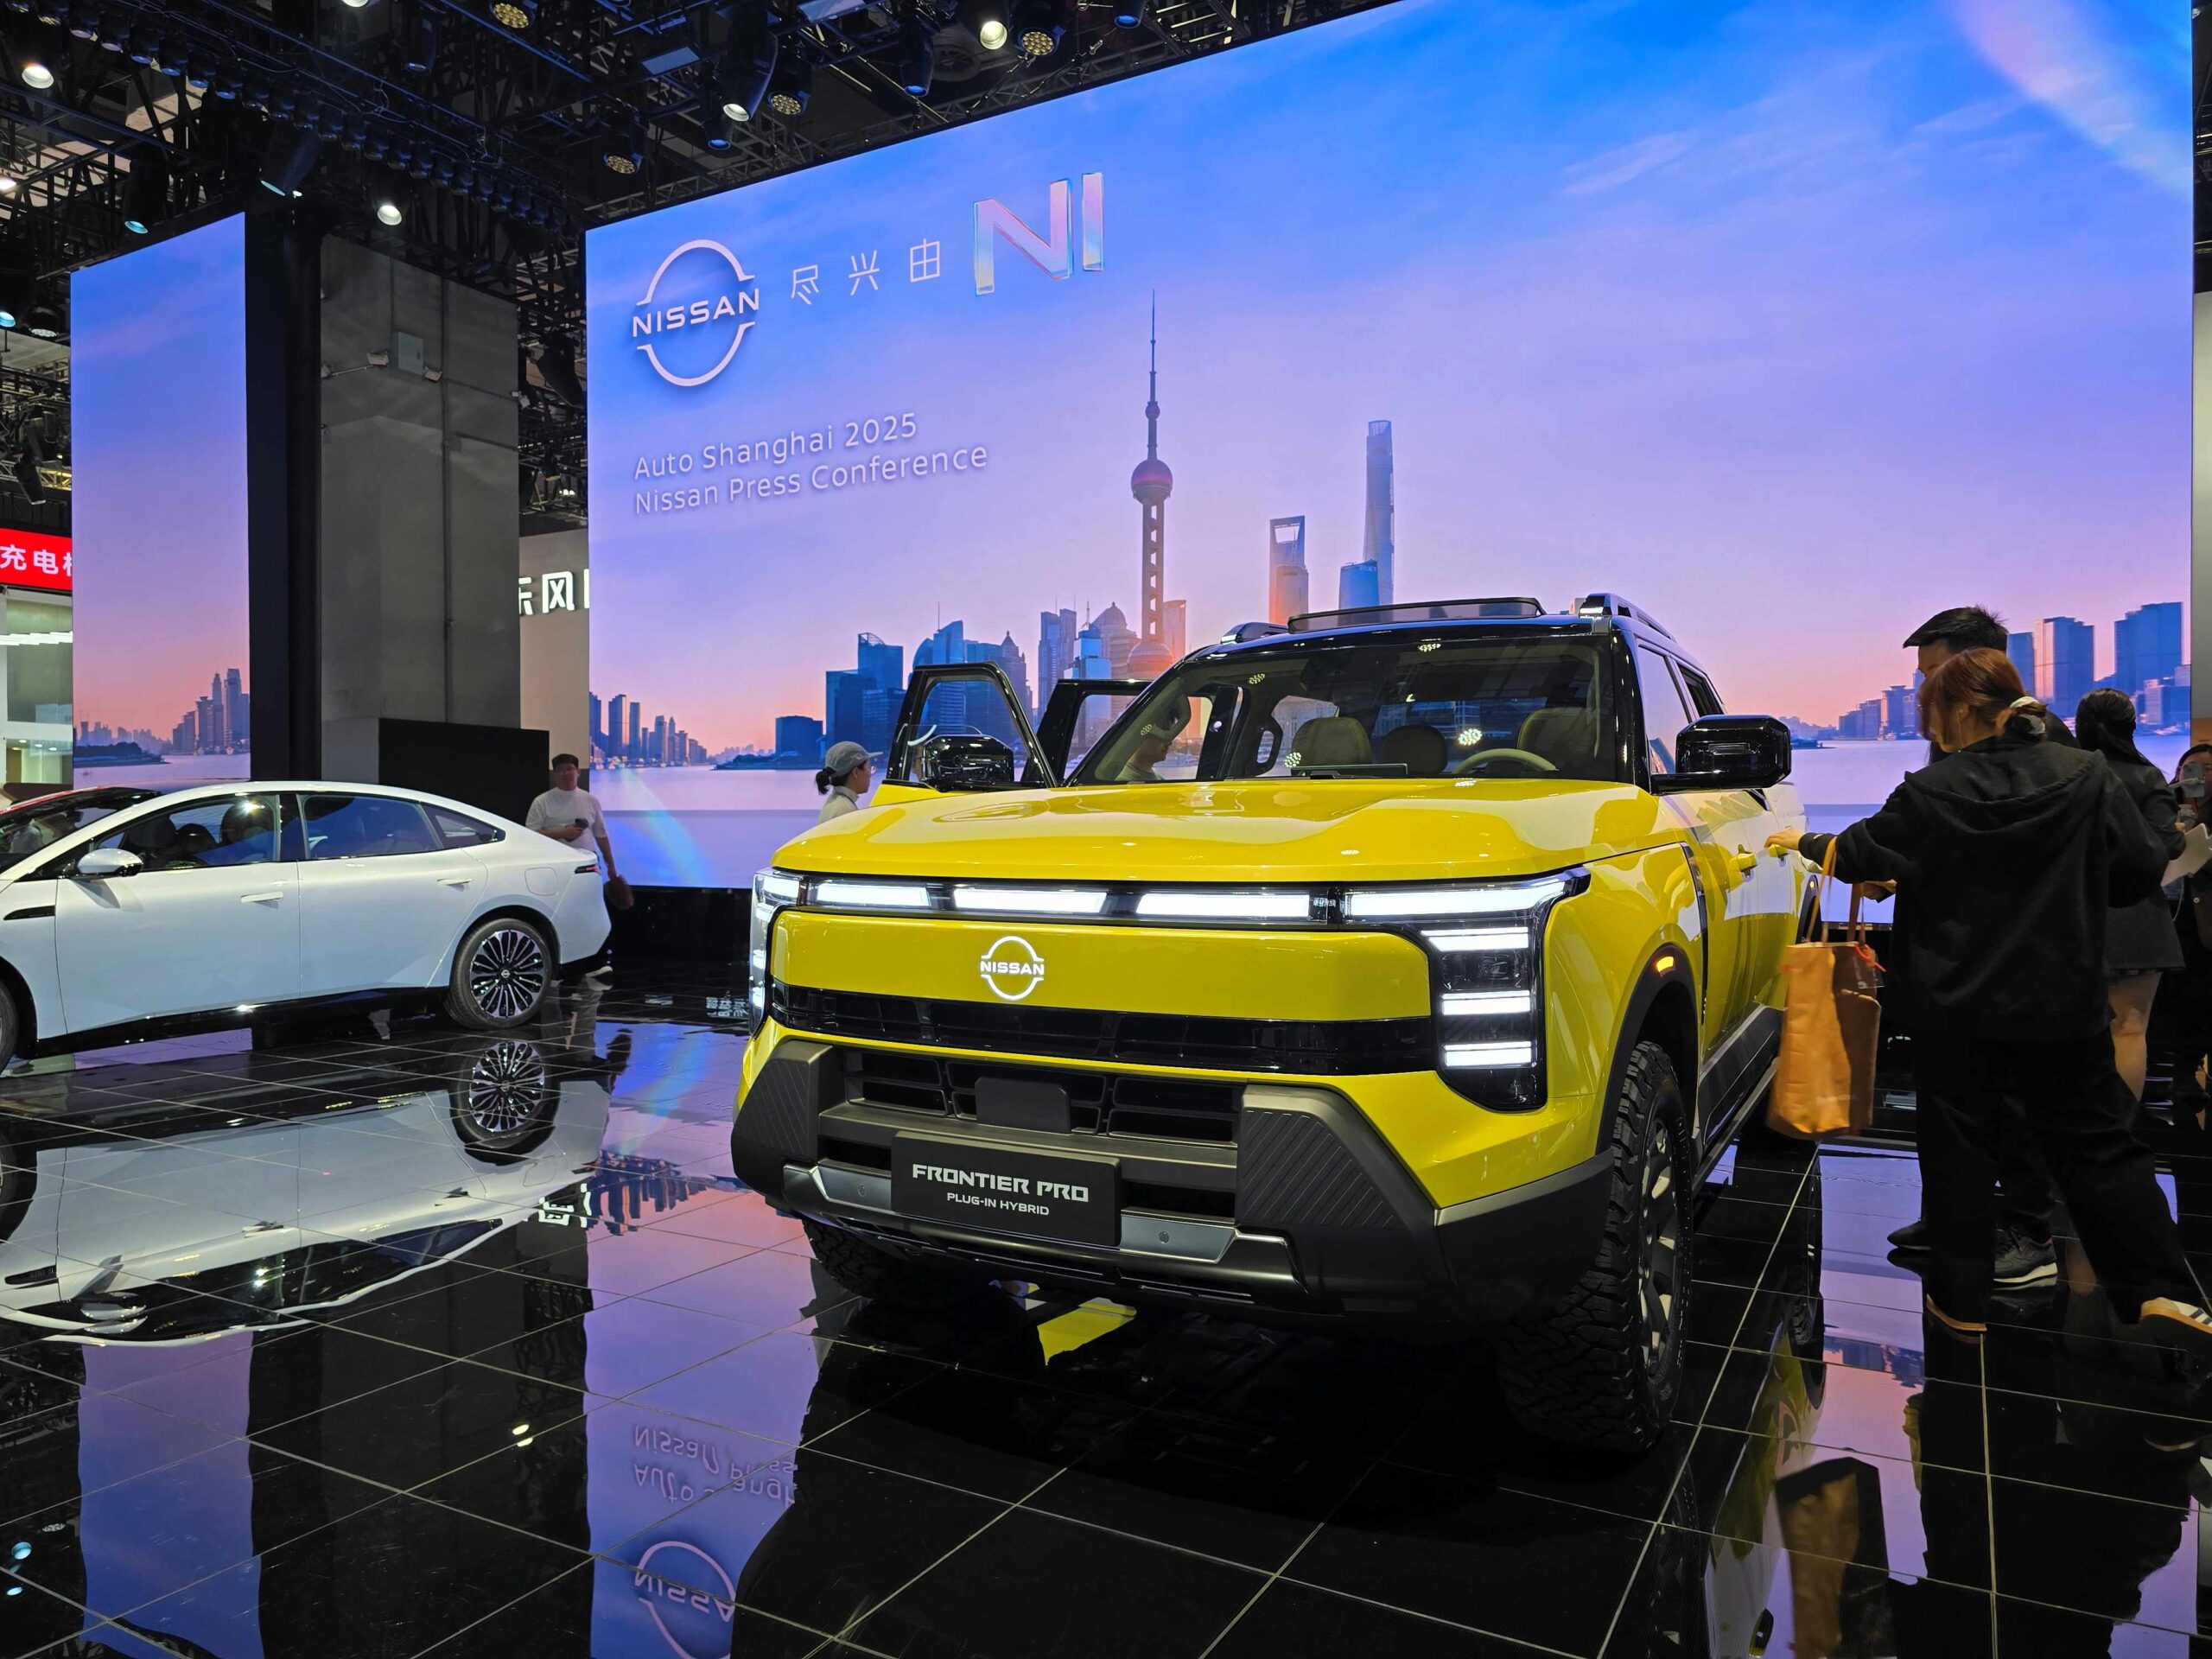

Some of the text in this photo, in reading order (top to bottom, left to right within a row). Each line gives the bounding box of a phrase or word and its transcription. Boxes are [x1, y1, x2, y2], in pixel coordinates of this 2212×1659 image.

[791, 238, 940, 305] 尽兴由
[632, 288, 760, 338] NISSAN
[634, 412, 918, 480] Auto Shanghai 2025
[636, 445, 988, 514] Nissan Press Conference
[980, 961, 1045, 976] NISSAN
[912, 1163, 1089, 1202] FRONTIER PRO
[947, 1192, 1050, 1216] PLUG-IN HYBRID
